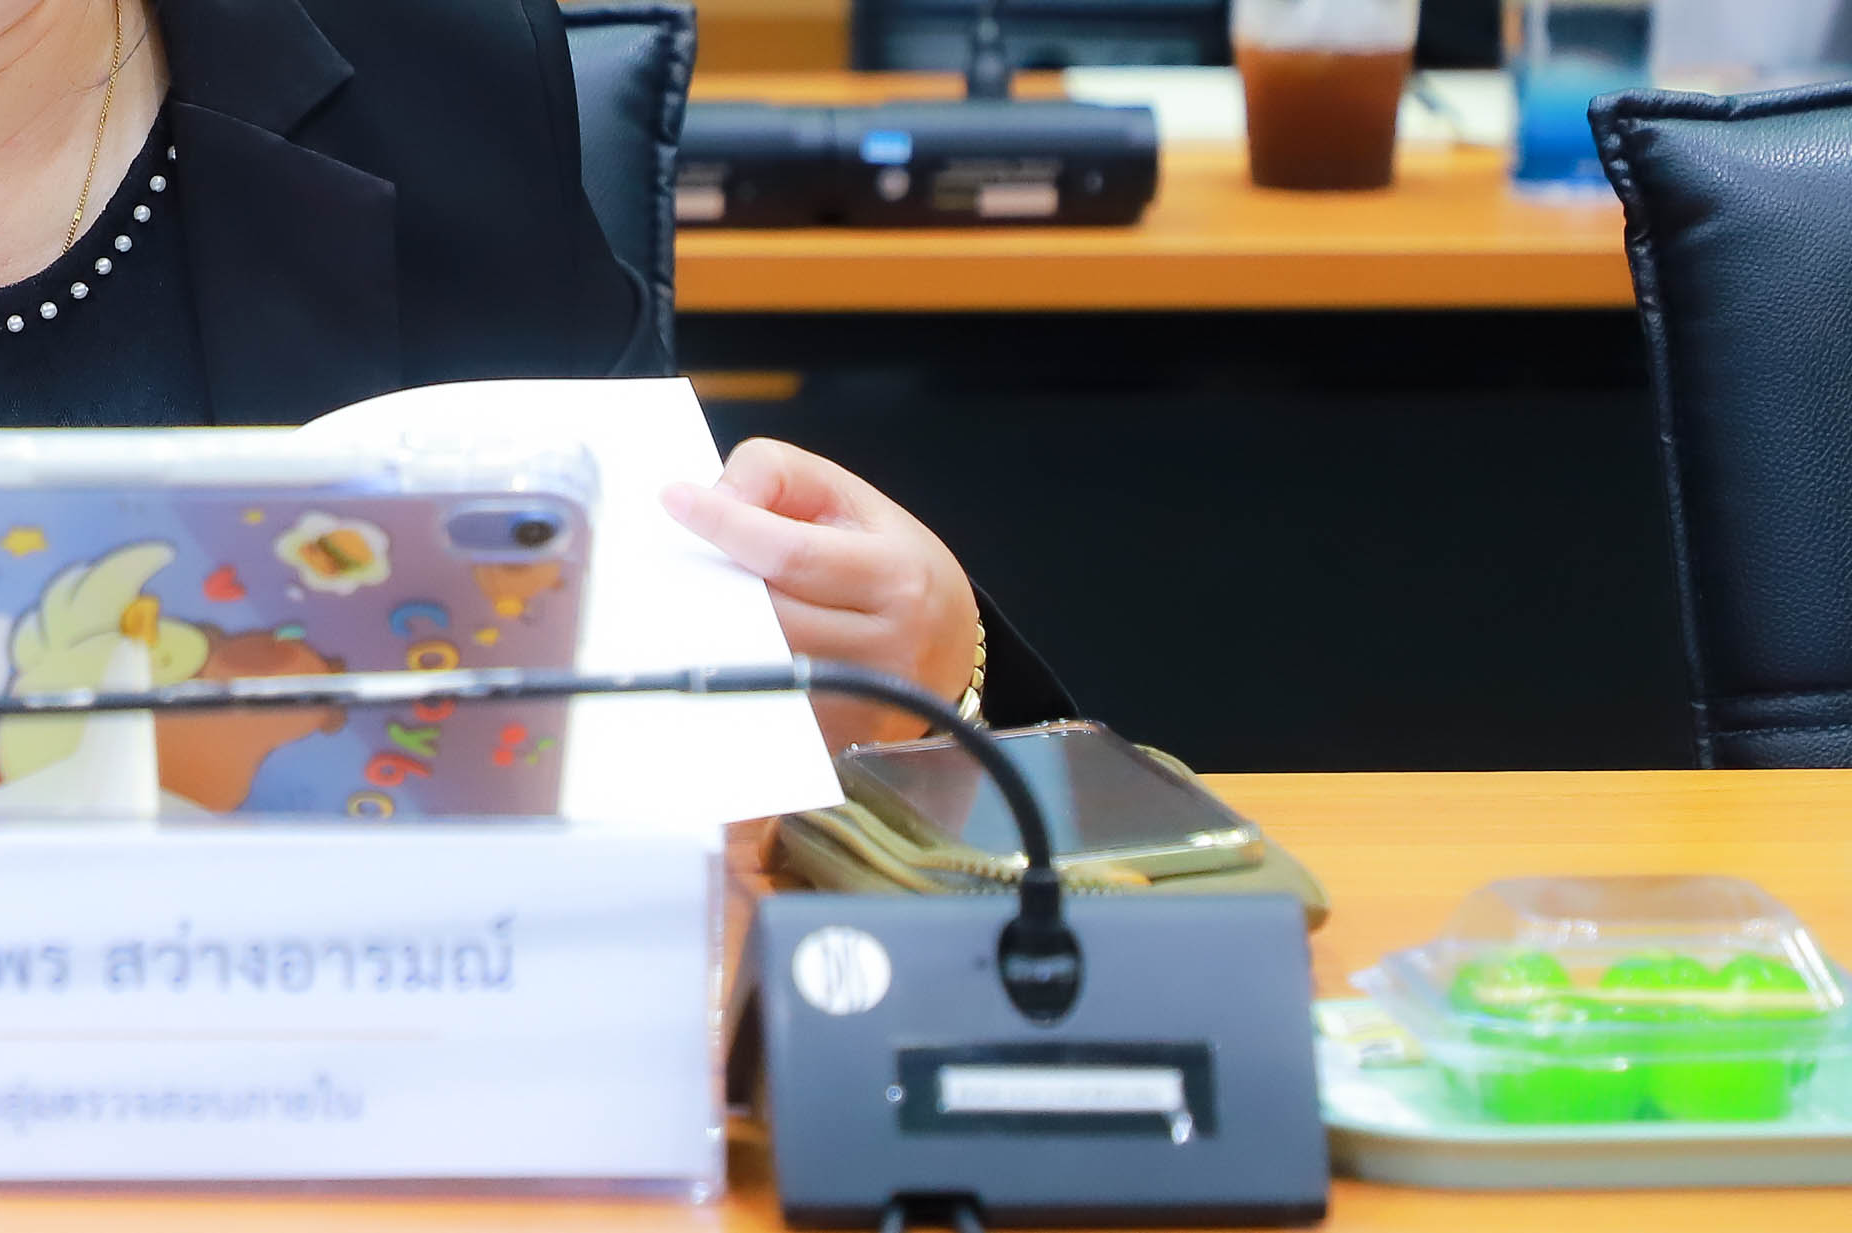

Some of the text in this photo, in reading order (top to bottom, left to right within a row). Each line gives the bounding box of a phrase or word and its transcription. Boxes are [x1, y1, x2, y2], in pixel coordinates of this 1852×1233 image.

[101, 914, 517, 997] สว่างอารมณ์
